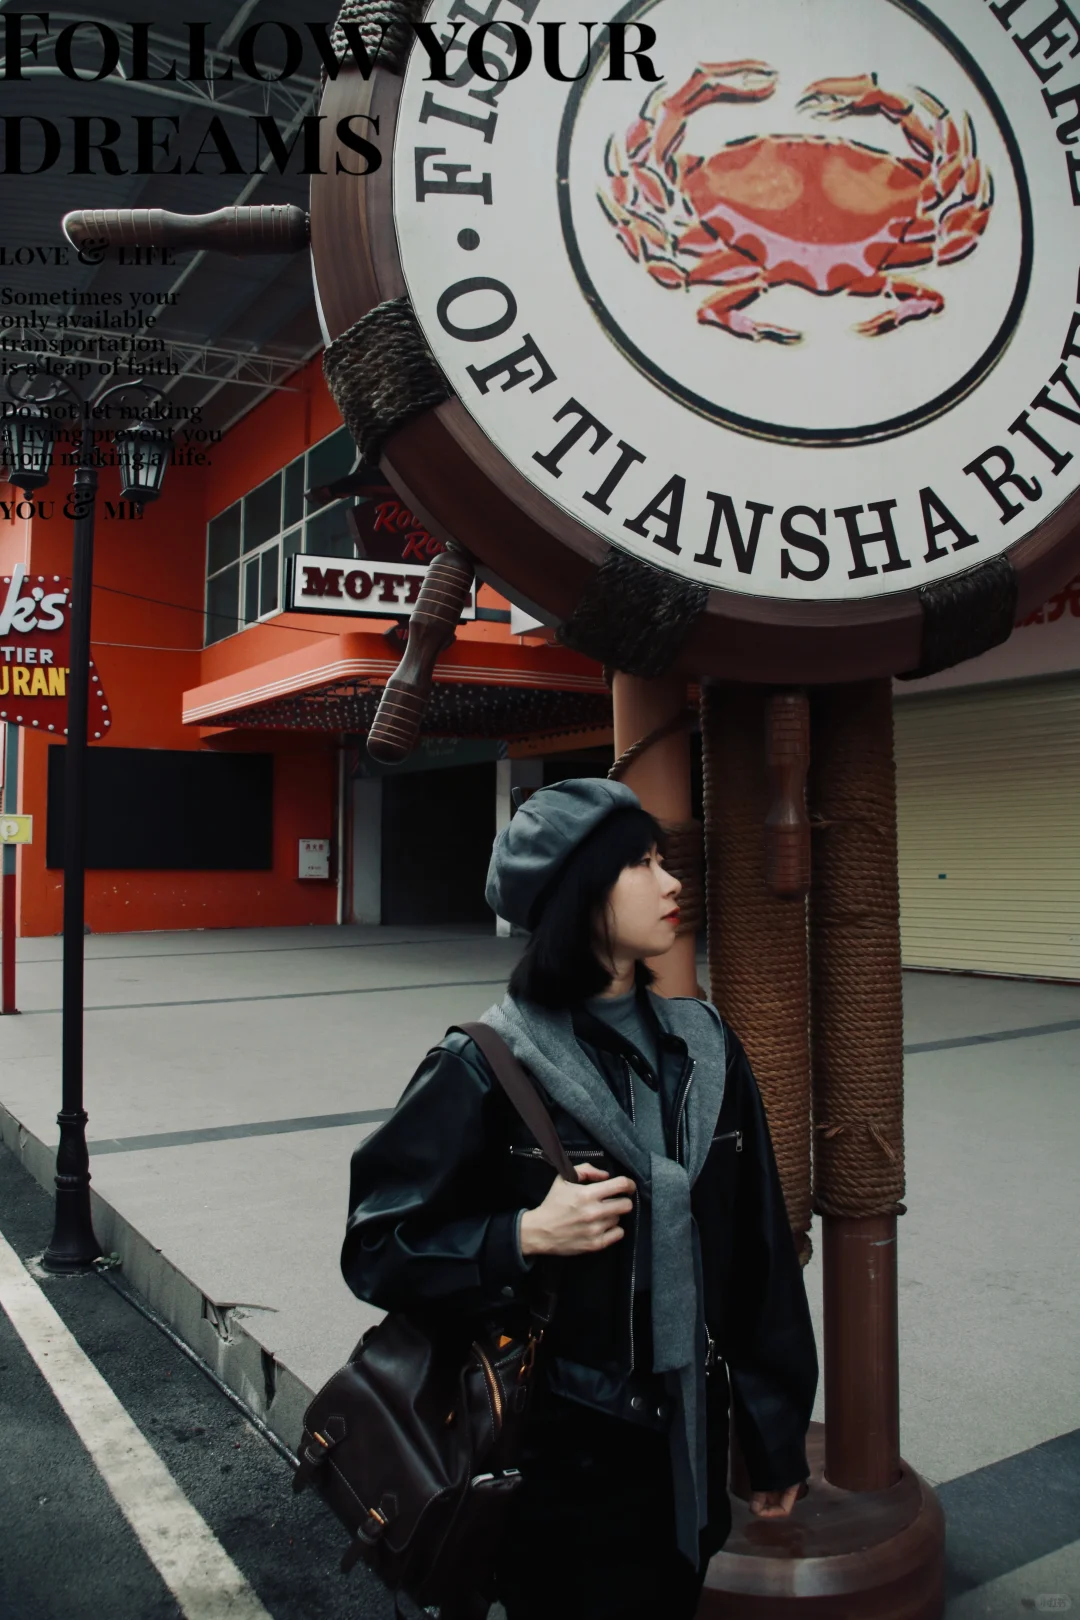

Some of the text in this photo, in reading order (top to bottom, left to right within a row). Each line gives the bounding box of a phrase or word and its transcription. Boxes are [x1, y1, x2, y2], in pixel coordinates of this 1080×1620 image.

[436, 276, 558, 395] OF
[531, 398, 977, 581] TIANSHA
[0, 646, 54, 664] TIER
